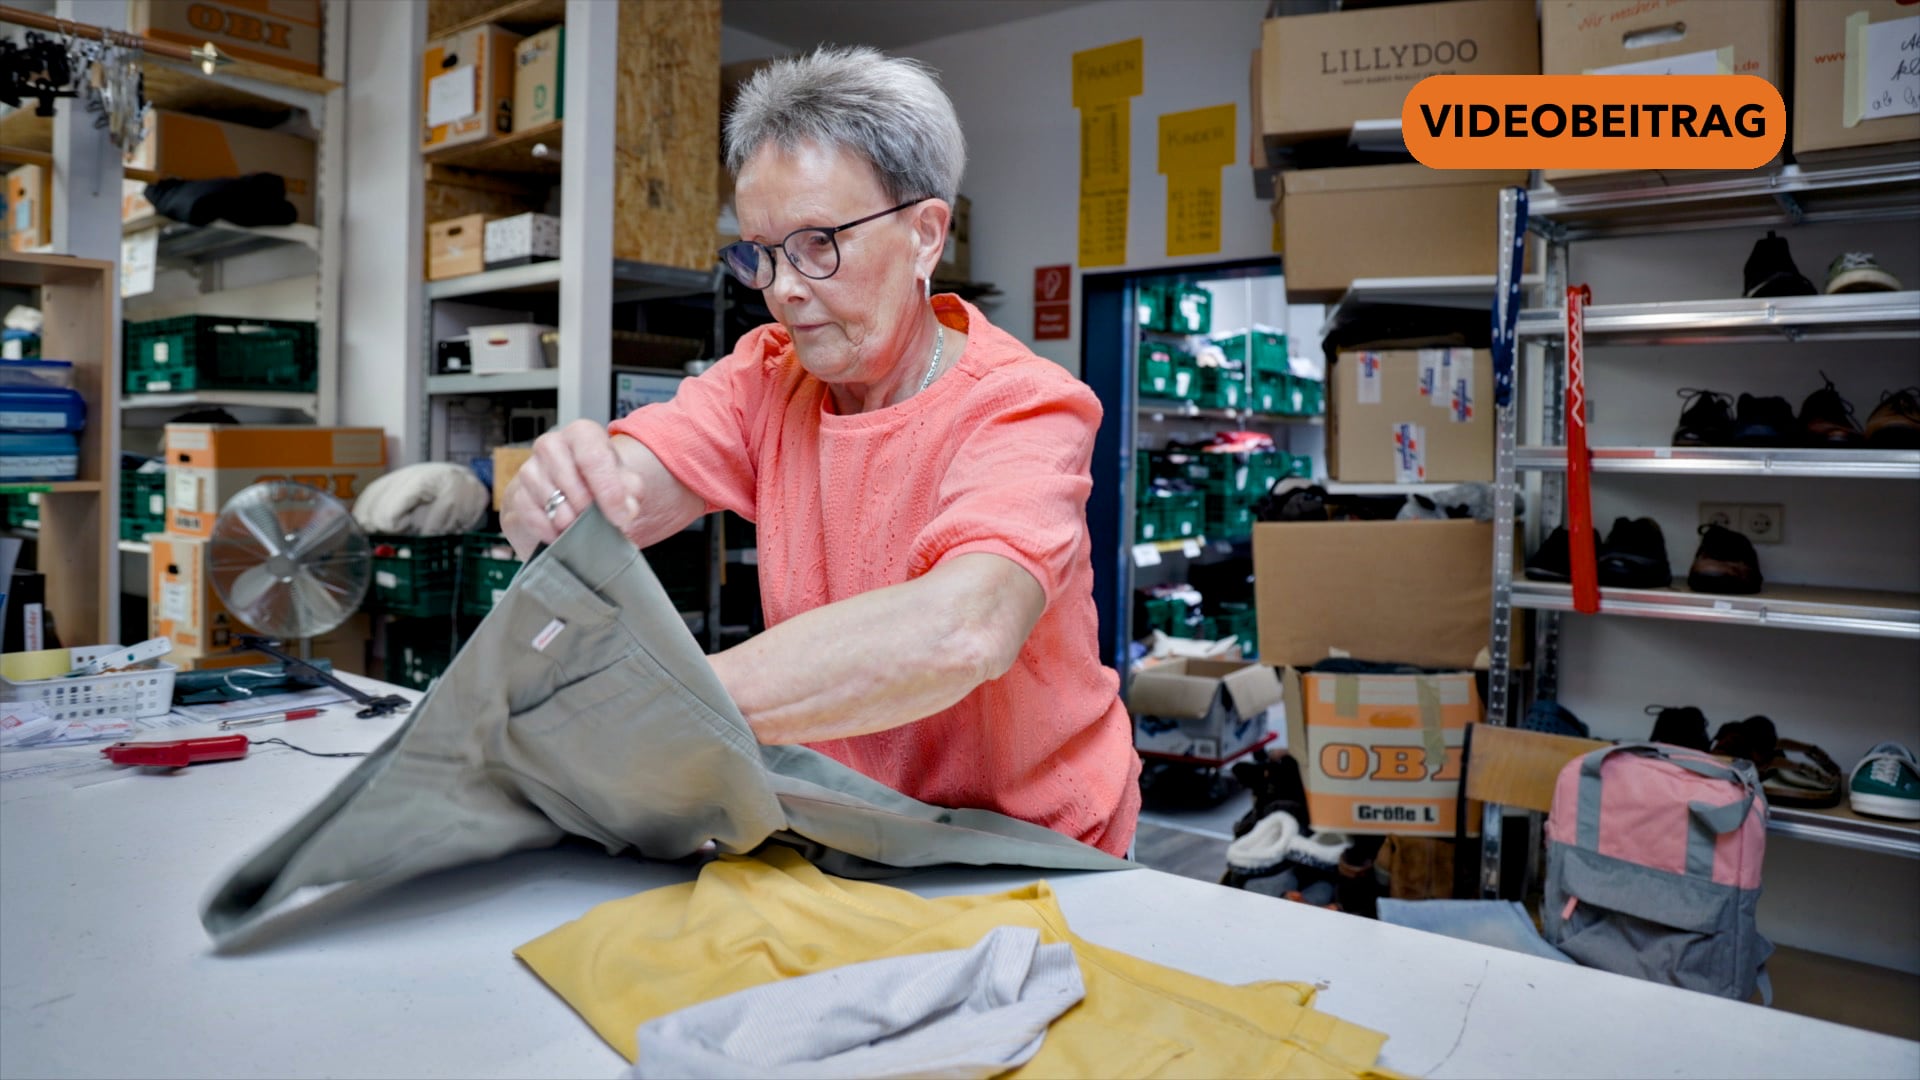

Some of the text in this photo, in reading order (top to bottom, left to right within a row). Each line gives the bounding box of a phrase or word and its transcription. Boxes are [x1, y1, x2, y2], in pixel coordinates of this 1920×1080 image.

[187, 3, 292, 49] OBI
[1320, 38, 1478, 75] LILLYDOO
[1358, 804, 1435, 823] Größe L
